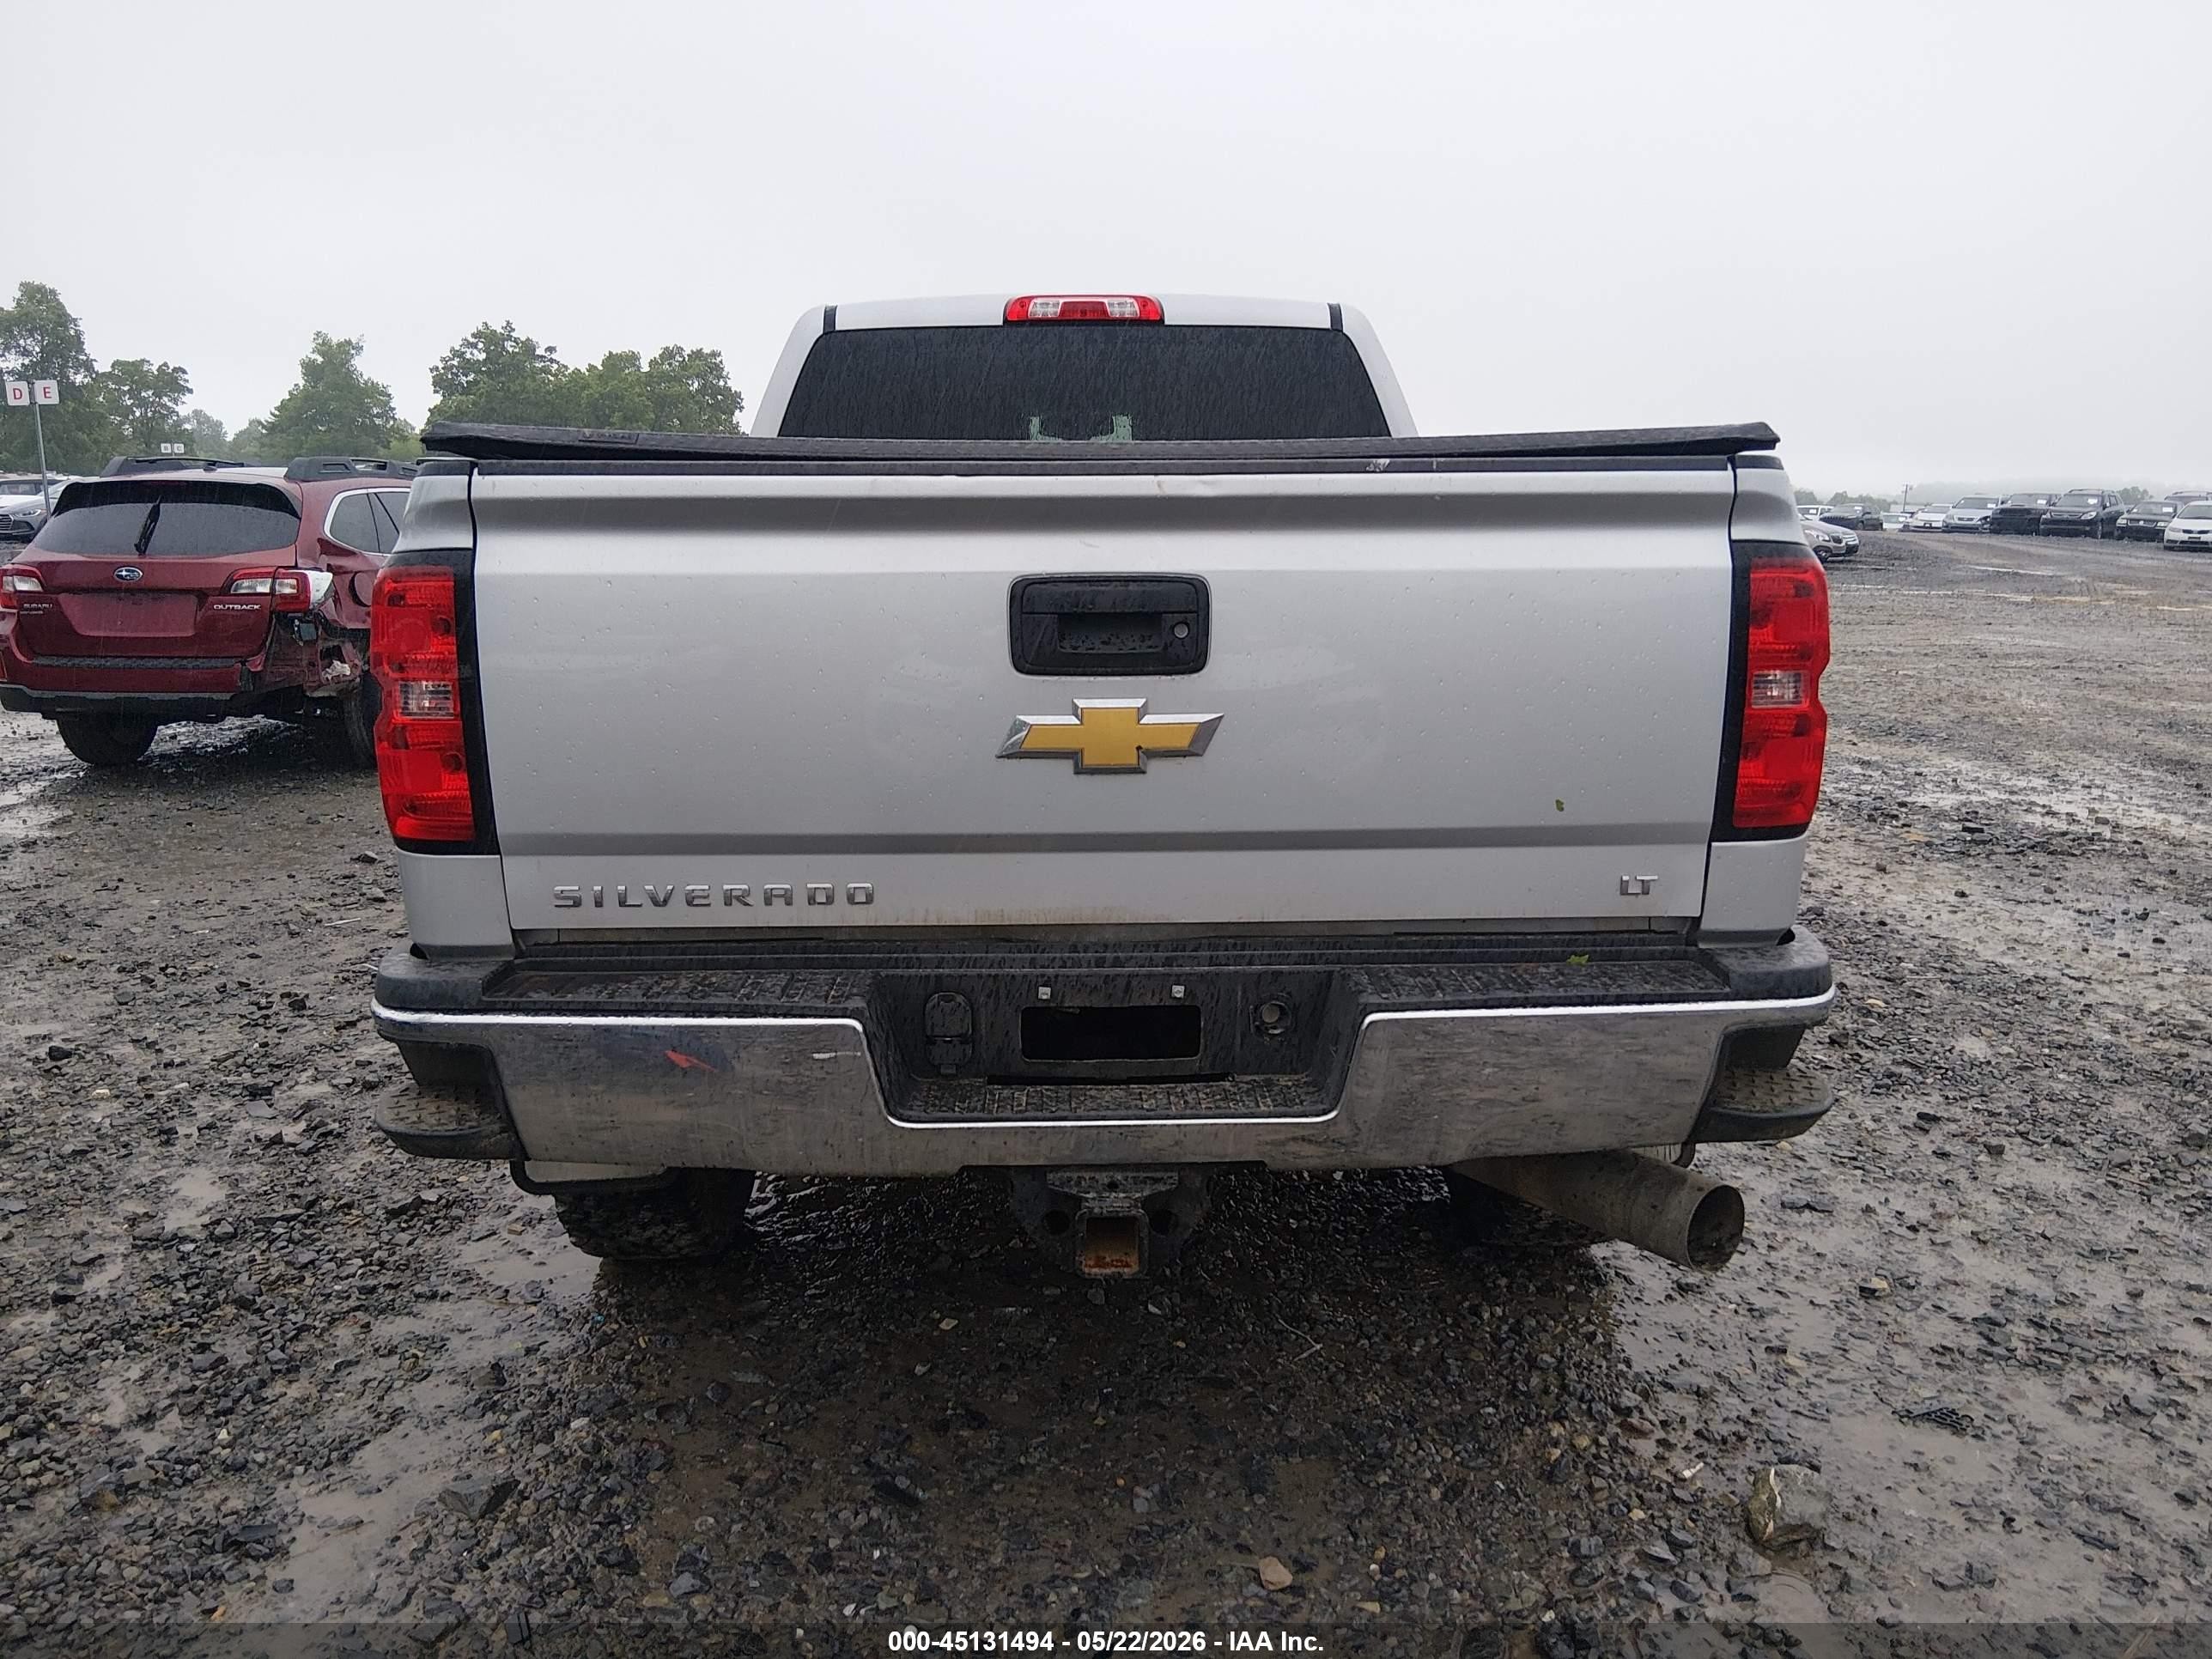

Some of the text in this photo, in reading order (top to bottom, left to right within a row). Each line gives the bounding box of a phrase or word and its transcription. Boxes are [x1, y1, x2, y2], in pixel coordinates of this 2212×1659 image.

[13, 387, 22, 400] D
[43, 386, 52, 399] E
[1620, 875, 1658, 896] LT
[554, 884, 875, 908] SILVERADO
